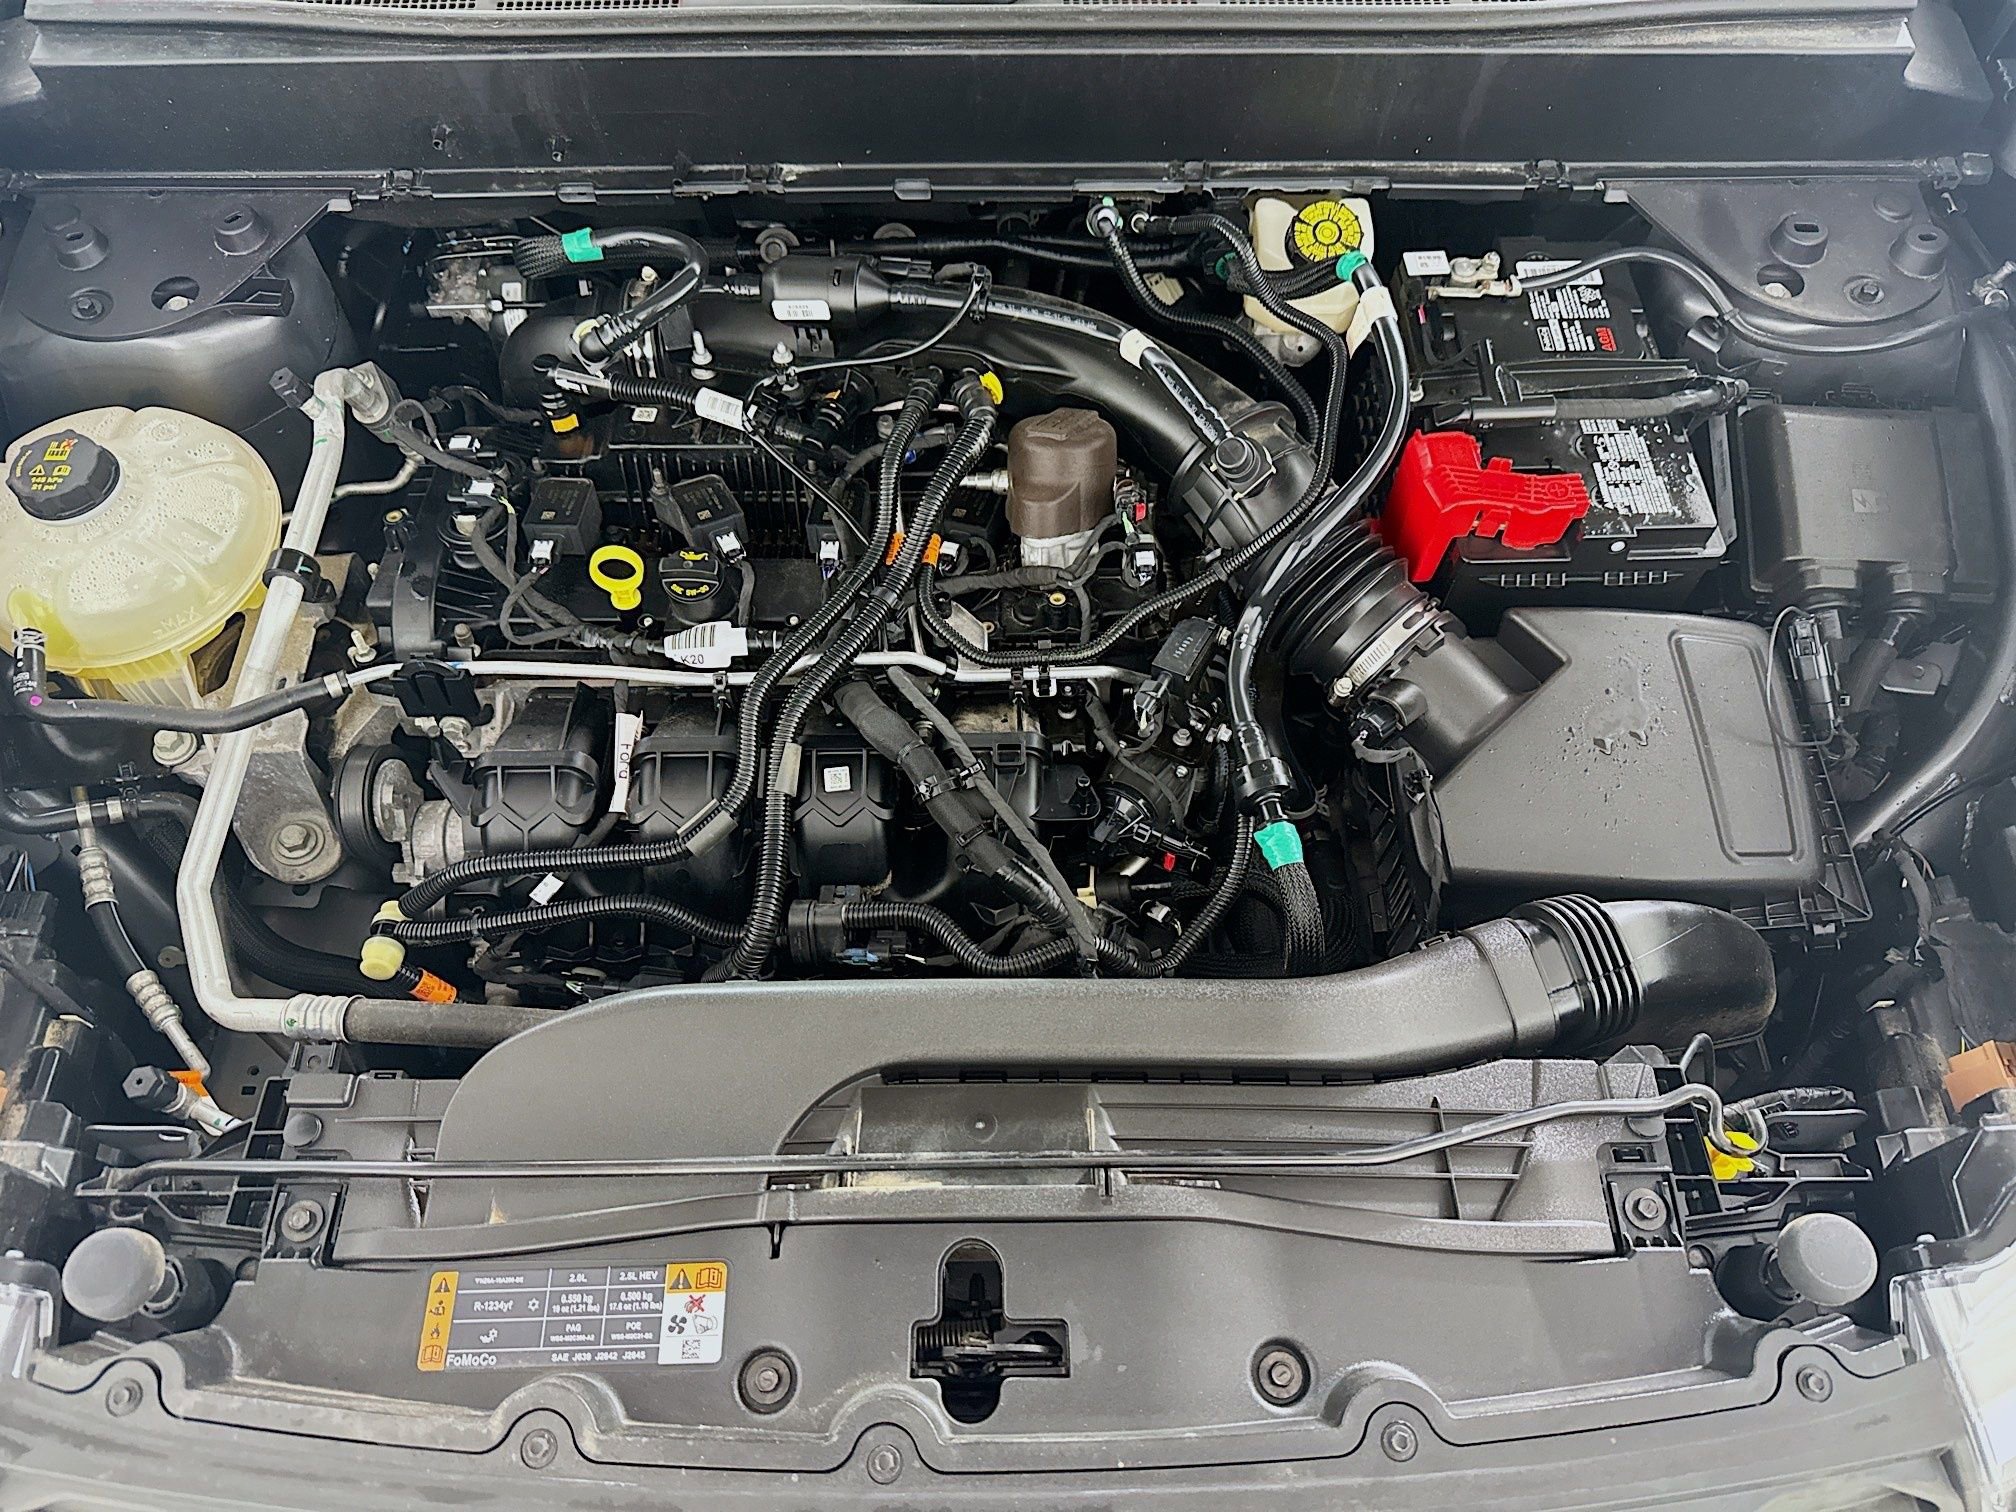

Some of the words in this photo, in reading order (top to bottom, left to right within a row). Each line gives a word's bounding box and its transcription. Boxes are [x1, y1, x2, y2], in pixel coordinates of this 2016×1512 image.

[681, 654, 704, 665] K20
[569, 1273, 587, 1283] 2.0L
[619, 1272, 638, 1281] 2.5L
[639, 1271, 658, 1280] HEV
[583, 1293, 594, 1305] kg
[642, 1291, 653, 1302] kg
[474, 1300, 513, 1312] R-1234yf
[565, 1323, 582, 1332] PAG
[446, 1353, 497, 1367] FoMoCo
[551, 1353, 569, 1362] SAE
